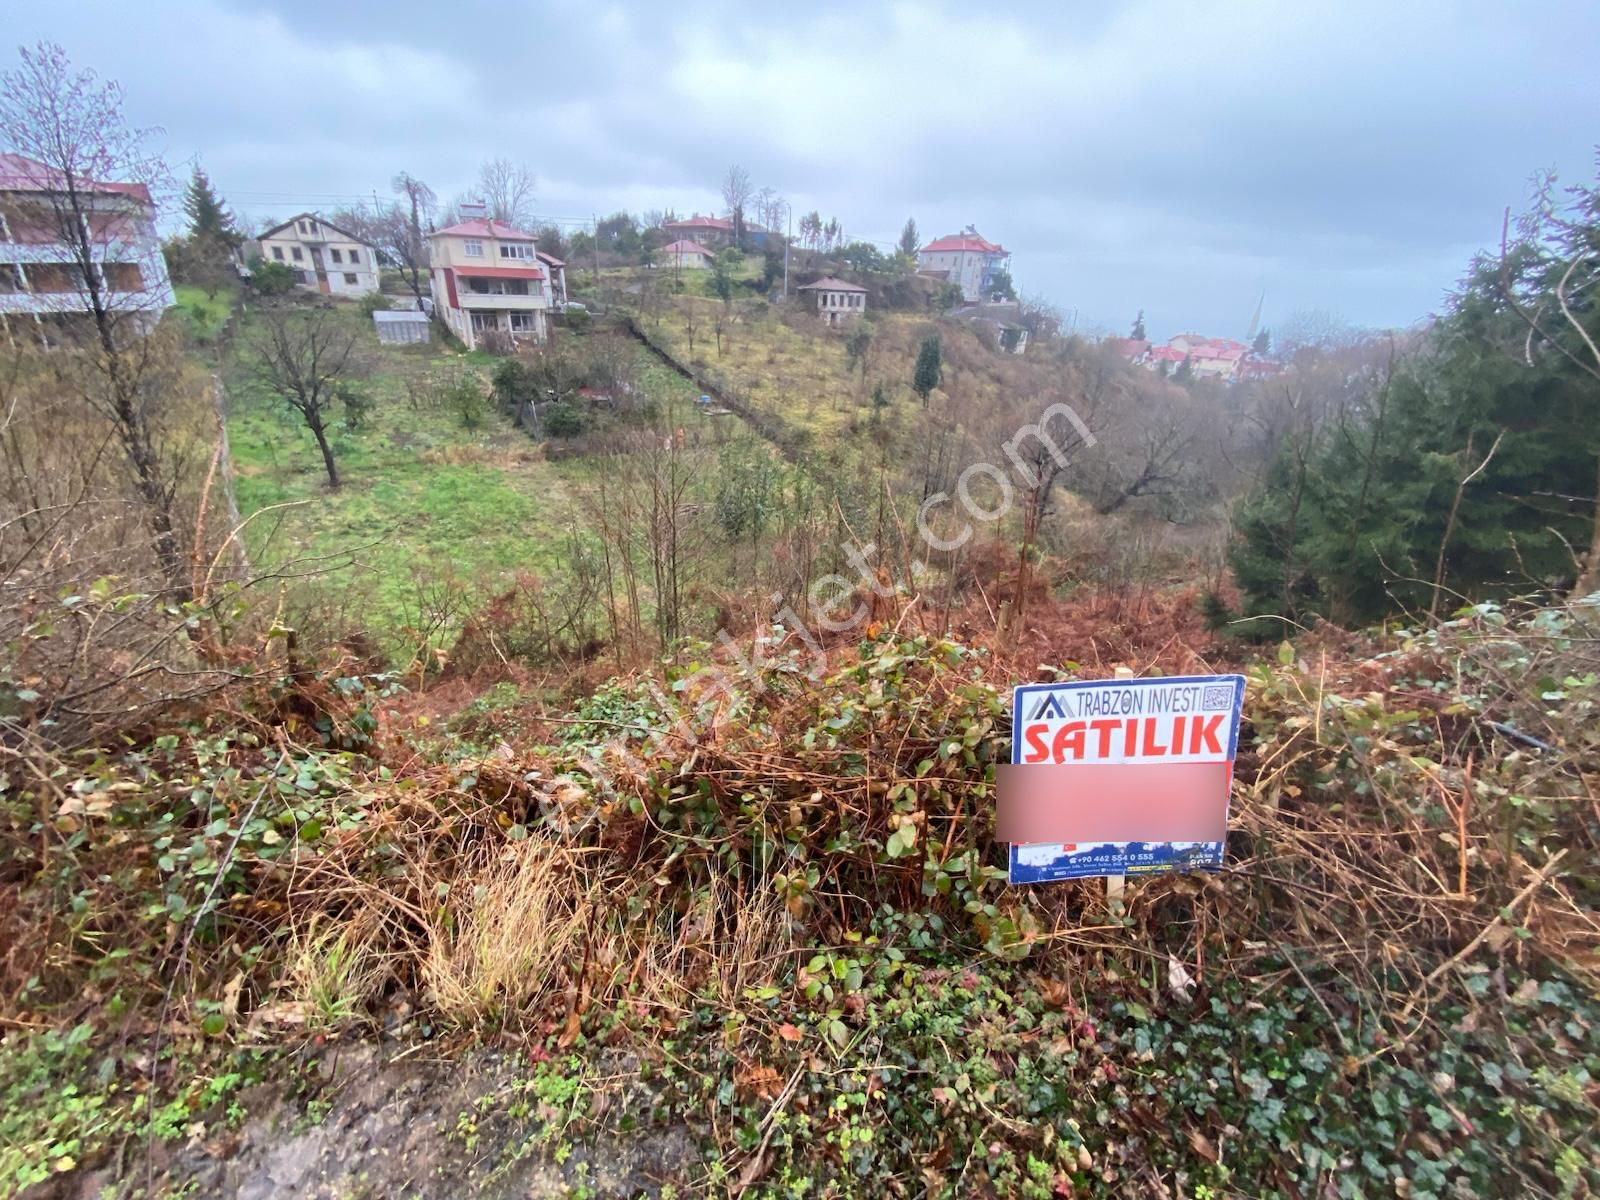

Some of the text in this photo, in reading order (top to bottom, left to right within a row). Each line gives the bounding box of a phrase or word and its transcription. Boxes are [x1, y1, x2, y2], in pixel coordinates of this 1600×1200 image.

[1076, 686, 1199, 718] TRABZON INVEST
[1024, 714, 1226, 765] SATILIK
[1094, 855, 1110, 863] 462
[1111, 854, 1128, 862] 554
